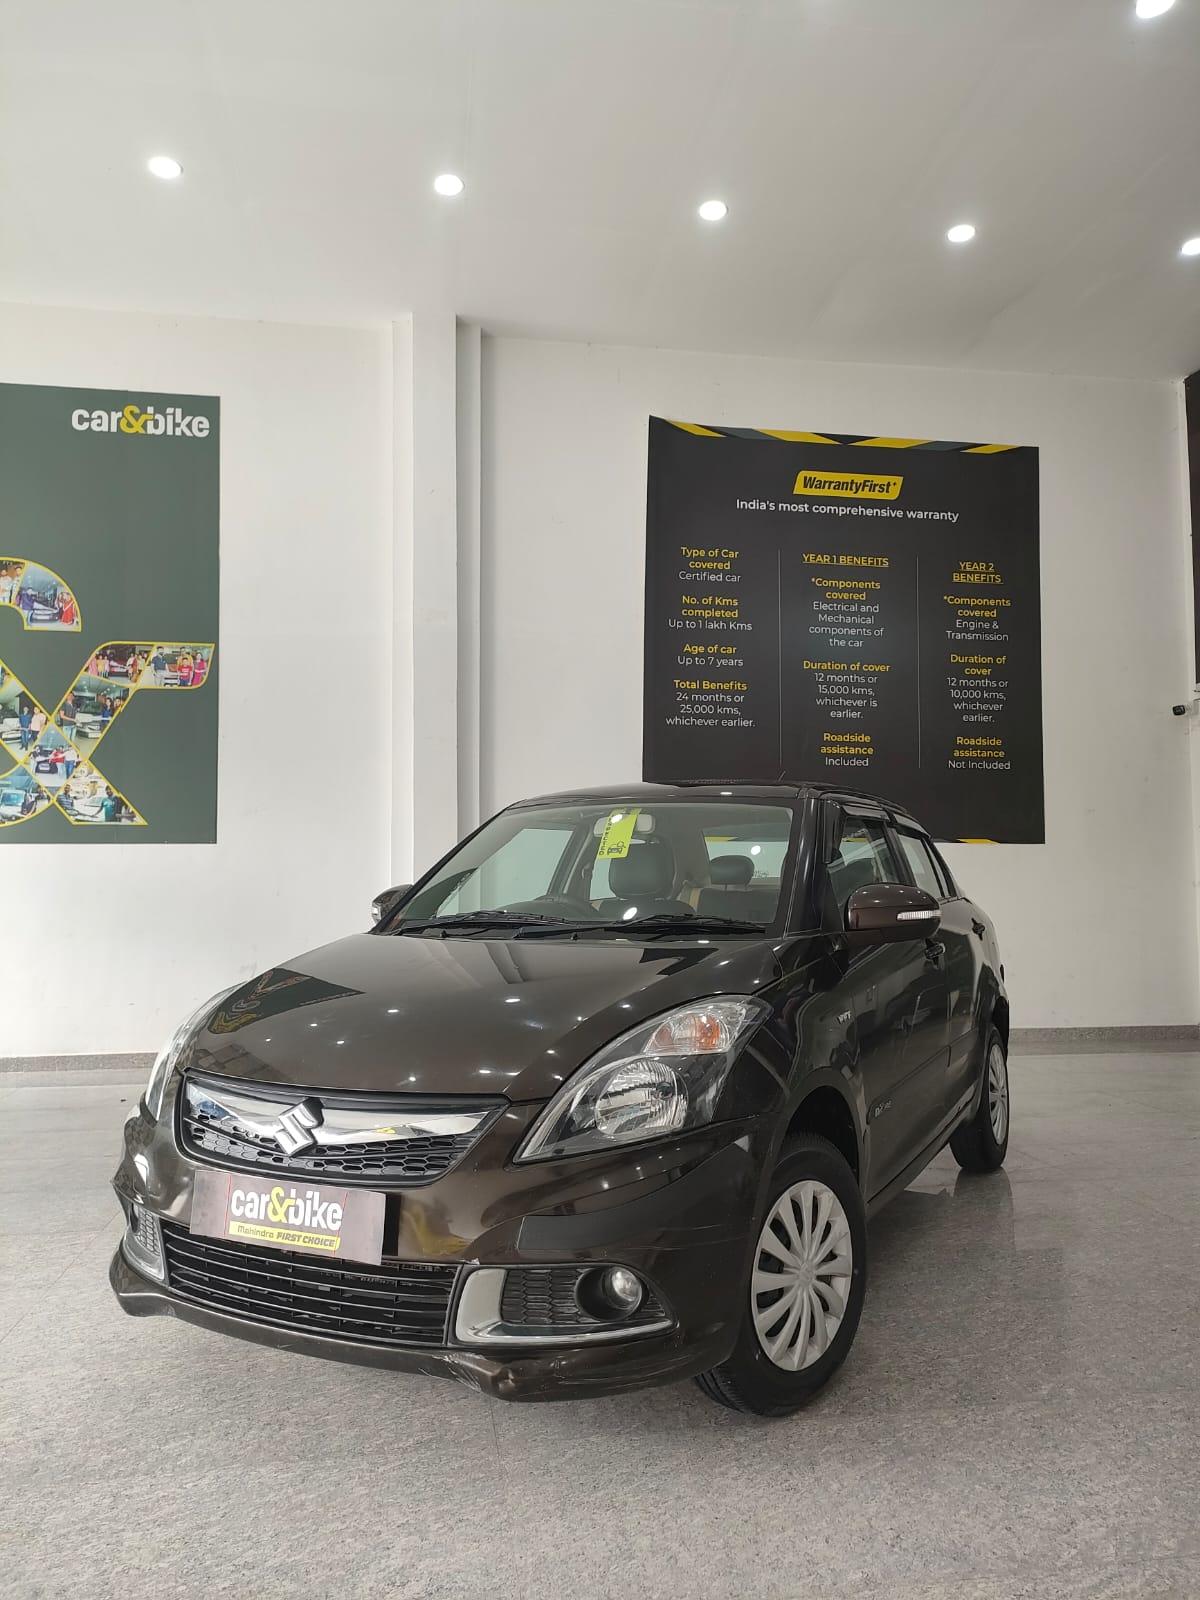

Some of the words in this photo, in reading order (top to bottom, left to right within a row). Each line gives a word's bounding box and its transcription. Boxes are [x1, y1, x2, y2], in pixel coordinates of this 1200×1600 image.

[71, 405, 210, 438] car&bike
[736, 499, 775, 511] India's
[779, 502, 809, 512] most
[812, 504, 903, 517] comprehensive
[907, 509, 959, 522] warranty
[681, 547, 705, 559] Type
[709, 548, 718, 557] of
[721, 549, 739, 558] Car
[689, 559, 730, 569] covered
[803, 553, 829, 563] YEAR
[839, 555, 889, 566] BENEFITS
[959, 561, 985, 571] YEAR
[679, 571, 722, 581] Certified
[725, 574, 741, 582] car
[952, 573, 1002, 583] BENEFITS
[826, 590, 865, 600] covered
[682, 596, 700, 605] No.
[703, 596, 712, 605] of
[716, 597, 738, 606] Kms
[813, 602, 857, 612] Electrical
[860, 603, 879, 613] and
[958, 608, 996, 617] covered
[682, 607, 738, 619] completed
[818, 614, 874, 624] Mechanical
[669, 619, 683, 630] Up
[686, 621, 696, 629] to
[705, 620, 726, 629] lakh
[729, 621, 752, 630] Kms
[956, 620, 991, 631] Engine
[809, 626, 871, 637] components
[874, 627, 883, 636] of
[946, 631, 1008, 641] Transmission
[830, 638, 846, 646] the
[848, 639, 863, 647] car
[684, 644, 705, 654] Age
[708, 644, 718, 653] of
[721, 646, 736, 654] car
[678, 656, 692, 667] Up
[695, 657, 705, 666] to
[716, 659, 743, 668] years
[951, 654, 993, 664] Duration
[997, 655, 1006, 664] of
[803, 660, 847, 671] Duration
[850, 661, 860, 671] of
[862, 664, 890, 672] cover
[965, 667, 991, 675] cover
[814, 674, 823, 682] 12
[827, 674, 864, 683] months
[947, 678, 956, 687] 12
[960, 679, 995, 688] months
[674, 680, 699, 689] Total
[703, 681, 747, 691] Benefits
[818, 685, 849, 696] 15,000
[852, 685, 875, 696] kms,
[676, 692, 688, 702] 24
[691, 692, 731, 702] months
[950, 690, 981, 700] 10,000
[984, 690, 1006, 701] kms,
[816, 697, 867, 706] whichever
[870, 698, 877, 707] is
[953, 701, 1003, 712] whichever
[680, 704, 714, 715] 25,000
[717, 705, 741, 716] kms,
[831, 709, 862, 719] earlier.
[666, 716, 718, 726] whichever
[721, 717, 755, 727] earlier.
[963, 713, 994, 723] earlier.
[824, 733, 871, 742] Roadside
[957, 736, 1002, 746] Roadside
[821, 745, 873, 755] assistance
[954, 748, 1004, 758] assistance
[825, 757, 868, 767] Included
[948, 760, 965, 769] Not
[968, 761, 1010, 770] Included
[231, 1187, 342, 1230] car&bike
[237, 1226, 274, 1237] Mahindra
[276, 1232, 302, 1242] FIRST
[303, 1236, 336, 1247] CHOICE
